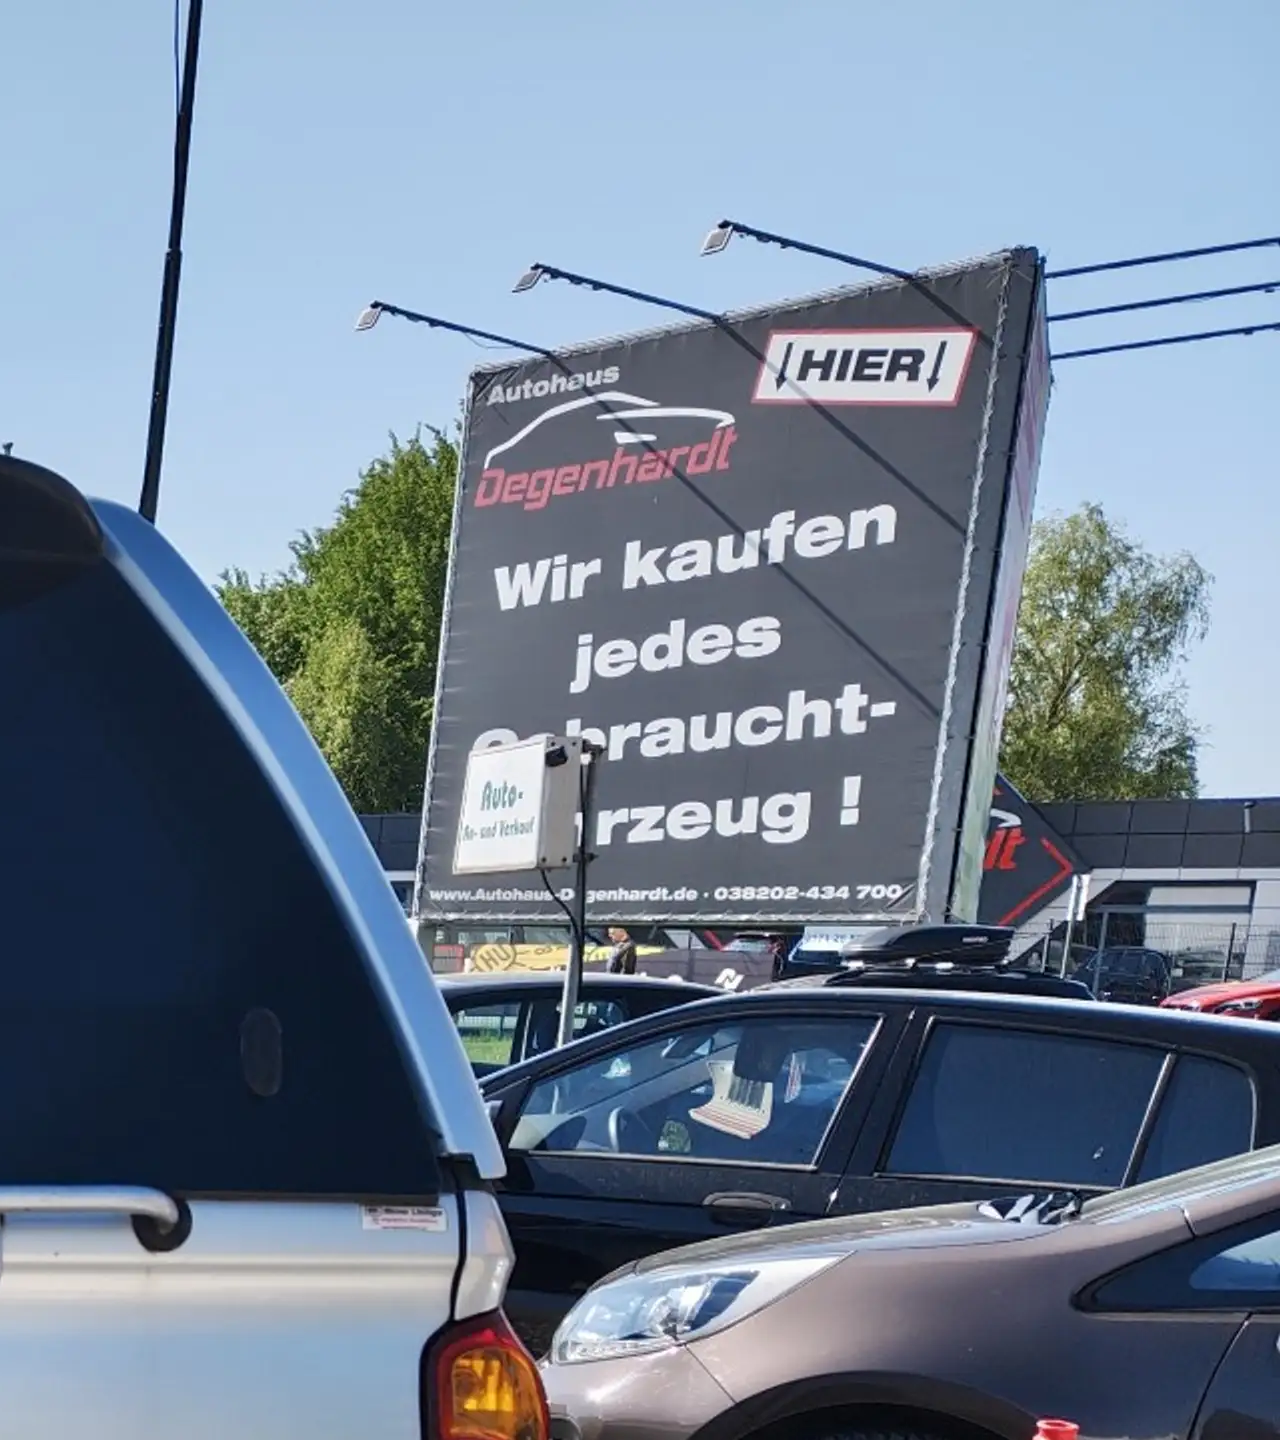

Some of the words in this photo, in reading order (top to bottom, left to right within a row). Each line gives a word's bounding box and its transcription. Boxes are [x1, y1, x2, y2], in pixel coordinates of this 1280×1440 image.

[487, 366, 620, 405] Autohaus
[797, 349, 925, 381] HIER
[474, 425, 738, 510] Degenhardt
[494, 554, 601, 610] Wir
[622, 503, 897, 590] kaufen
[569, 615, 781, 693] jedes
[473, 684, 896, 761] braucht-
[480, 780, 523, 811] Auto-
[429, 888, 697, 904] www.Autohaus-Dgenhardt.de
[714, 885, 850, 900] 038202-434
[856, 884, 903, 899] 700
